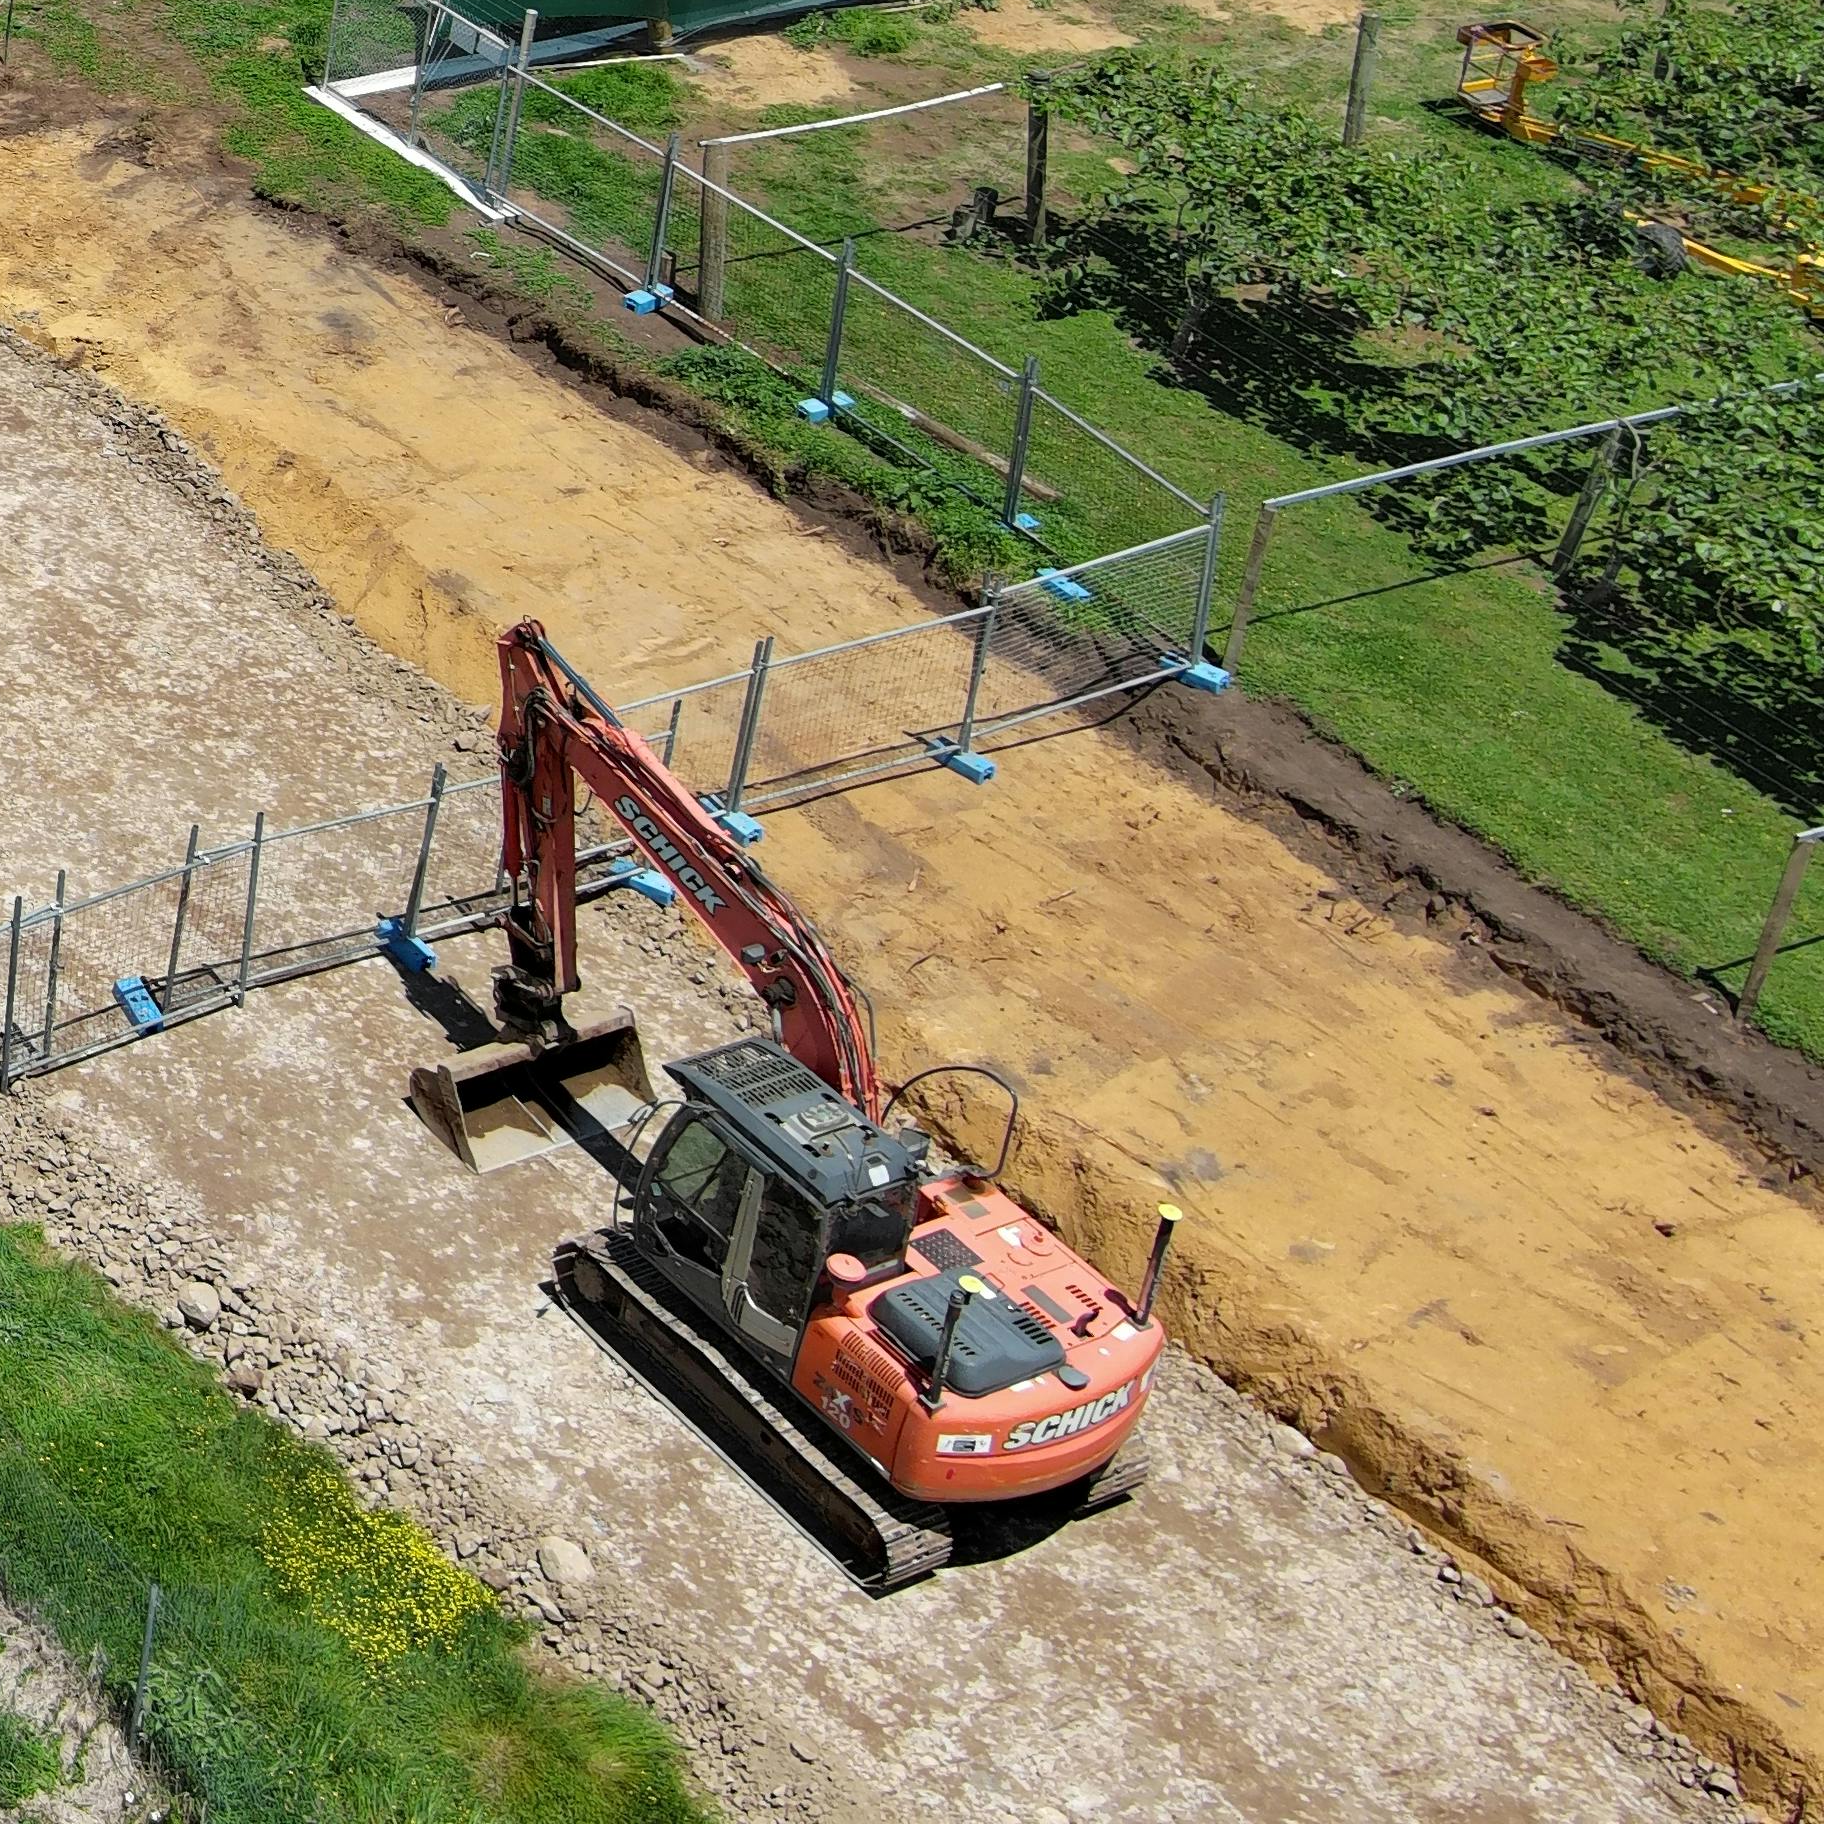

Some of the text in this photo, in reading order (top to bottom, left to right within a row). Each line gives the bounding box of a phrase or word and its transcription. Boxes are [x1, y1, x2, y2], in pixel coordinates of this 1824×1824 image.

[614, 795, 729, 916] SCHICK
[821, 1395, 851, 1430] 120
[1002, 1381, 1135, 1451] SCHICK
